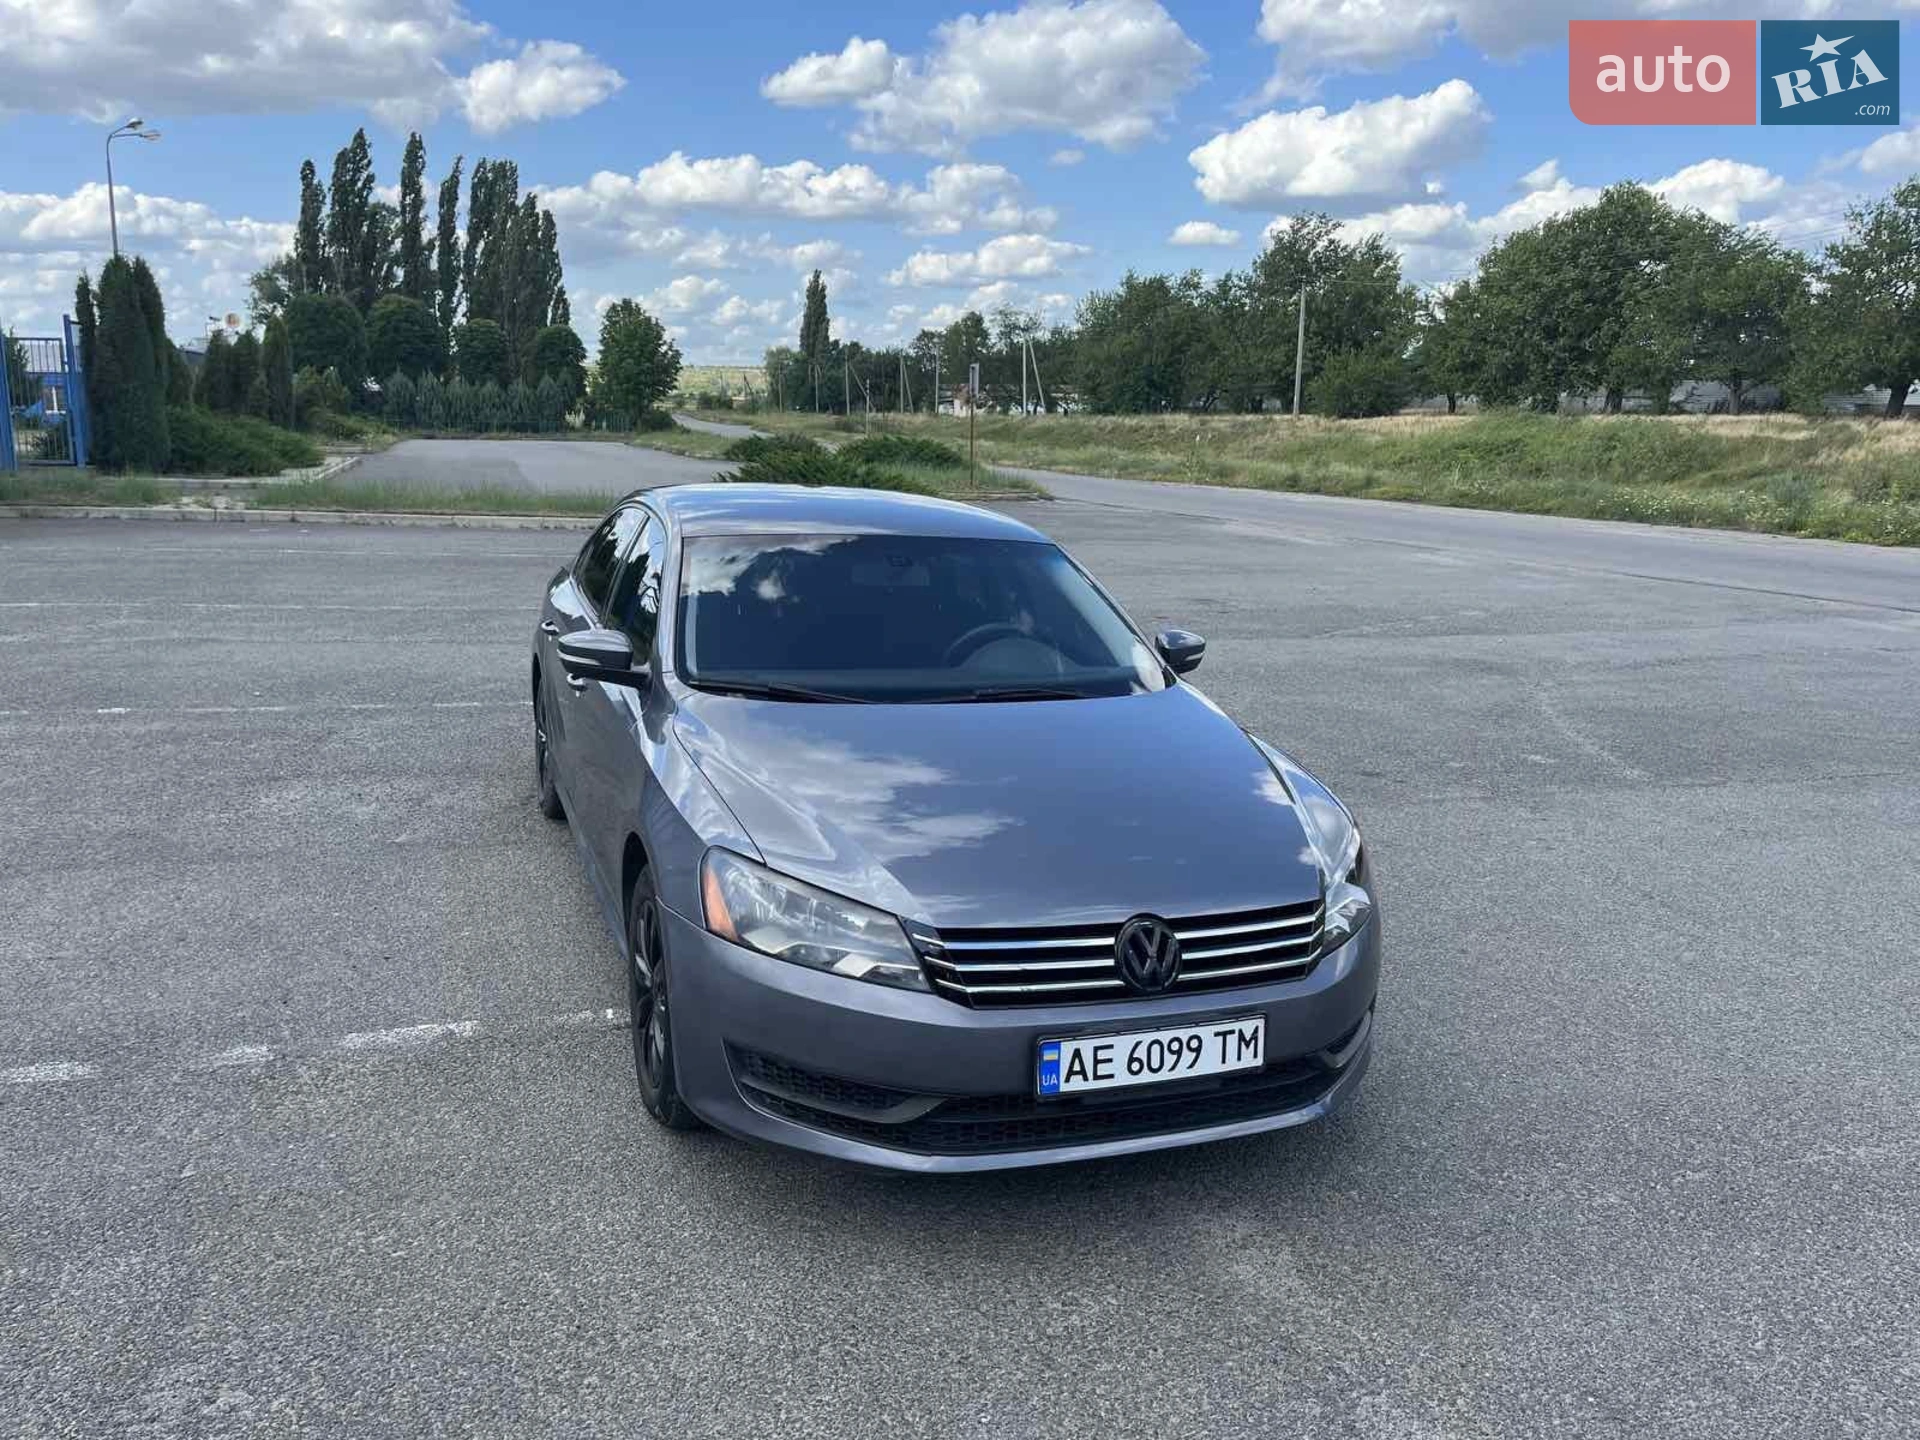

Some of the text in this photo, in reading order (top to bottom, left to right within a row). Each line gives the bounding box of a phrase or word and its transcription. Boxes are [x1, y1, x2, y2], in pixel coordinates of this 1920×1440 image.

[1064, 1025, 1260, 1083] AE 6099 TM
[1042, 1073, 1059, 1086] UA
